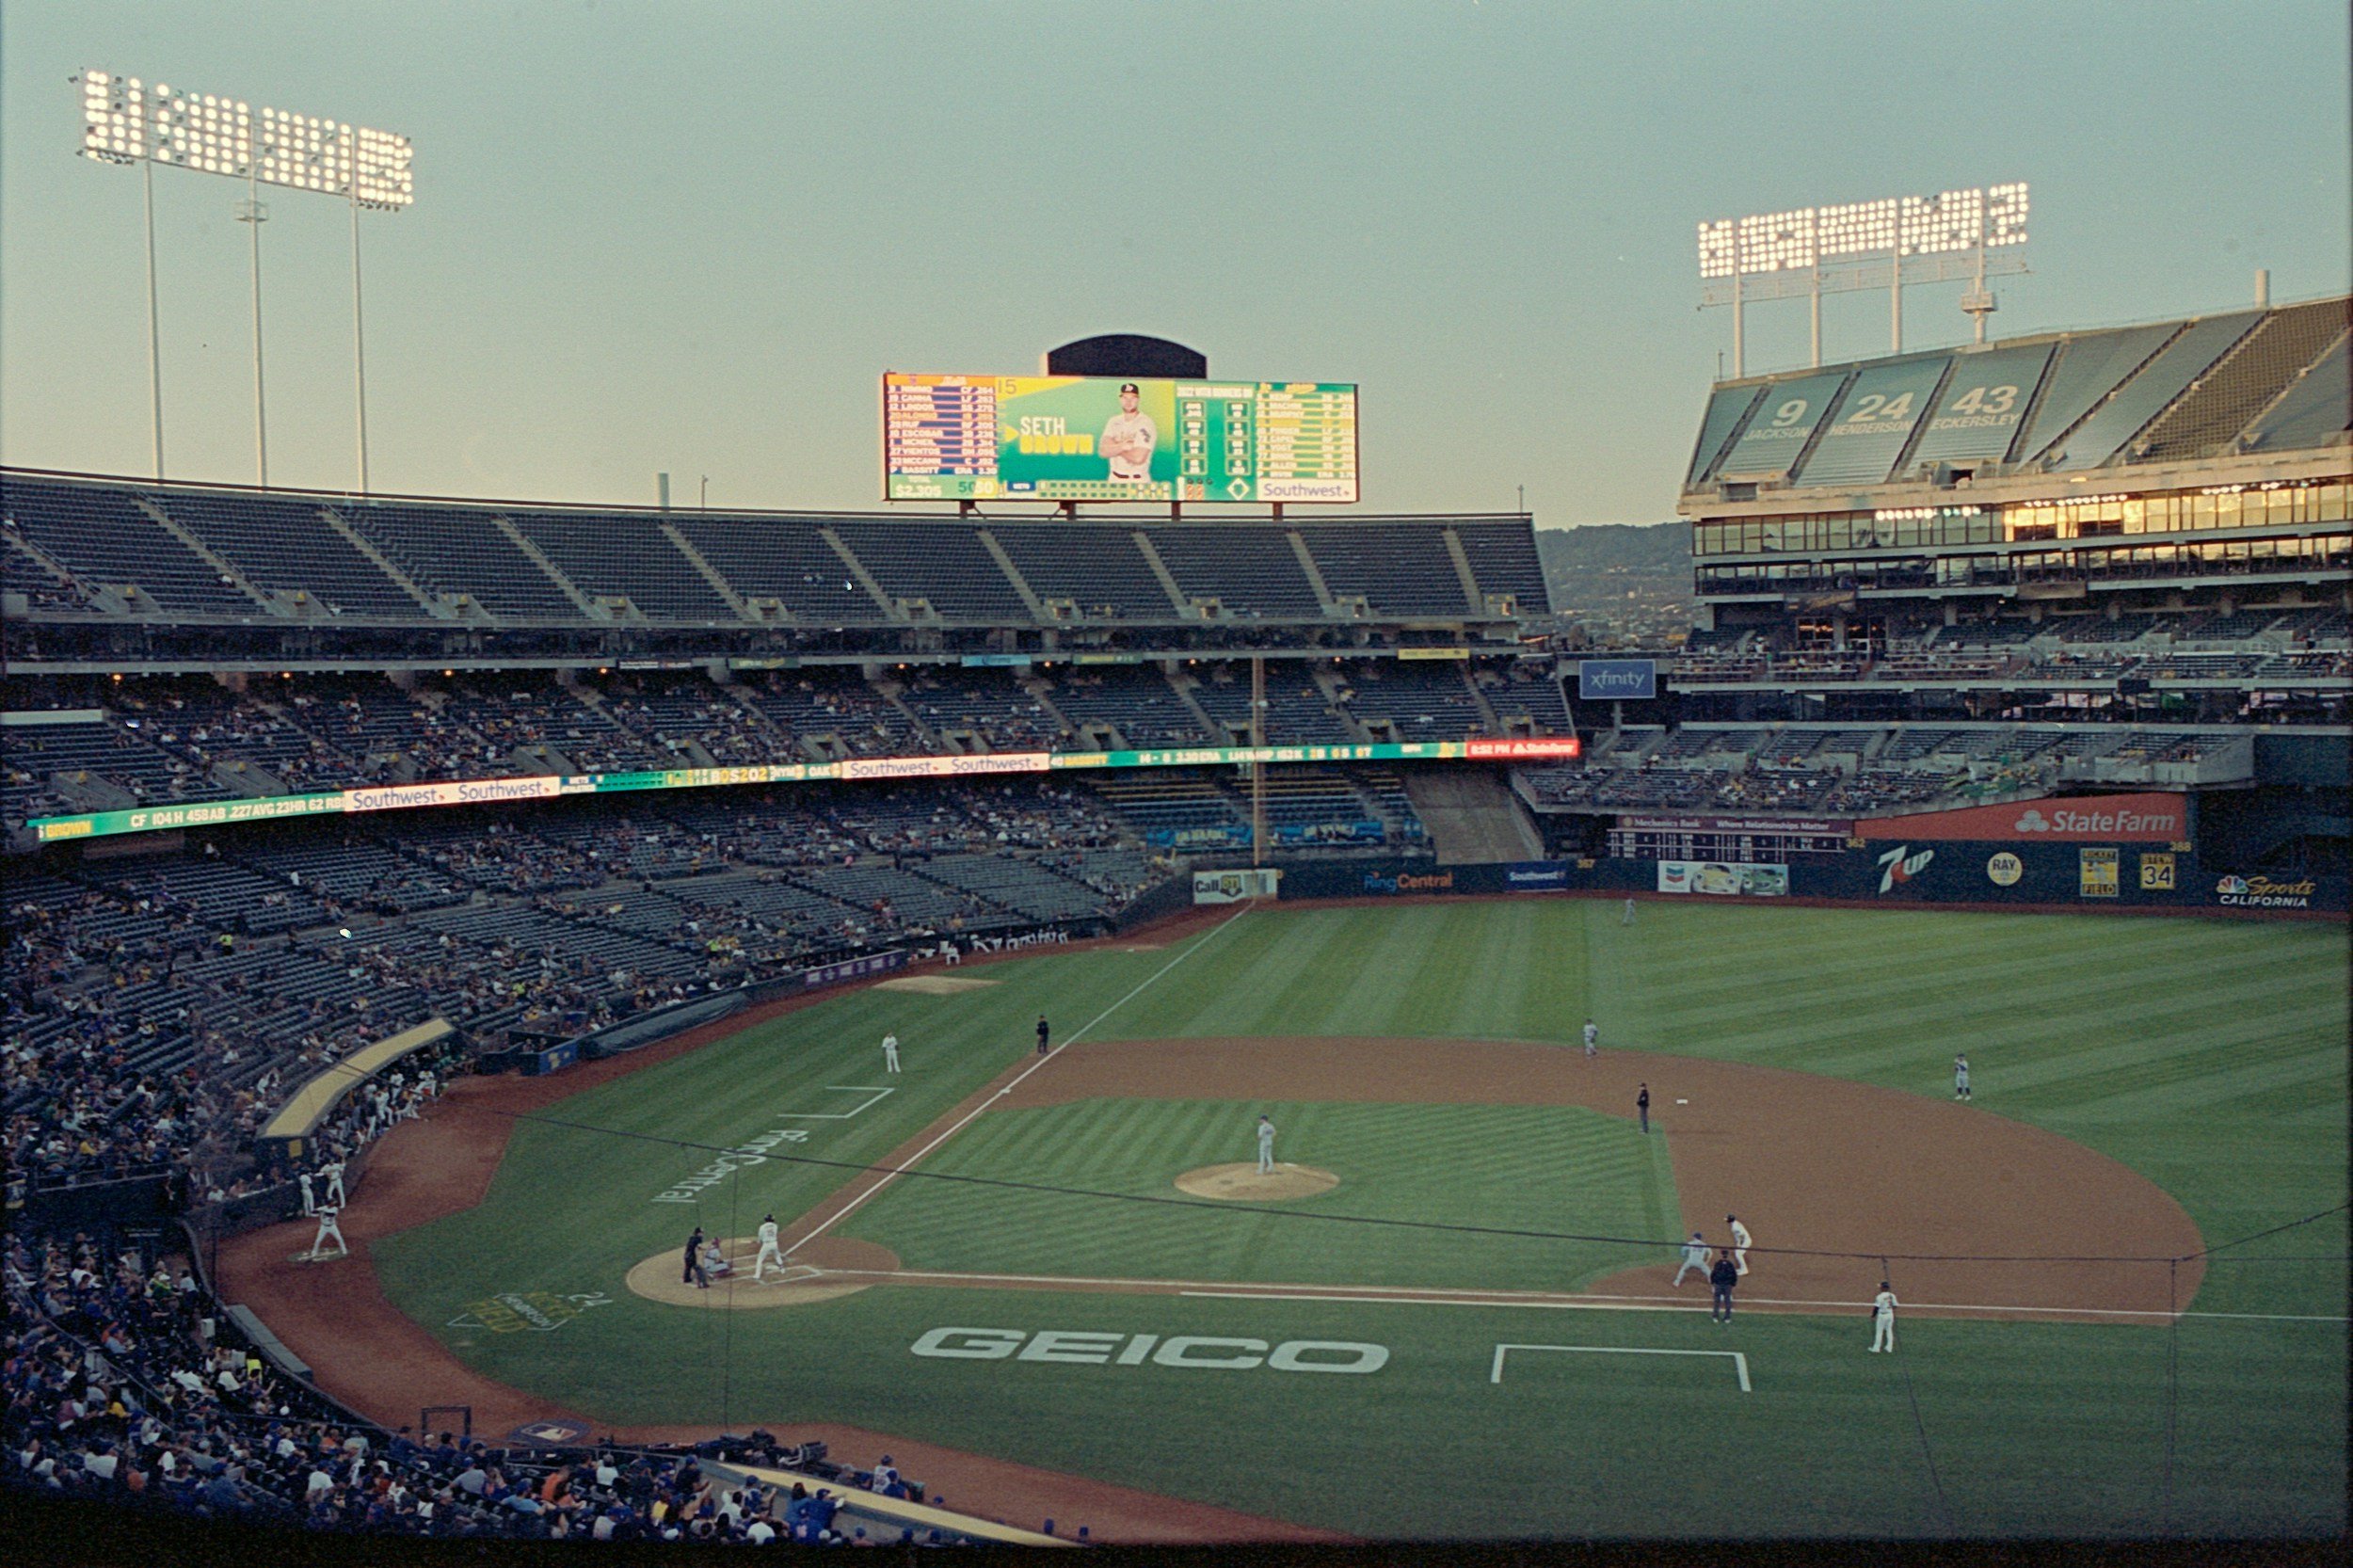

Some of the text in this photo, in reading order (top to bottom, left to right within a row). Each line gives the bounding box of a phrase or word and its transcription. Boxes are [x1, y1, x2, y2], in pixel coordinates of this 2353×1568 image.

[998, 379, 1016, 394] 15
[1848, 392, 1913, 423] 24
[1950, 386, 2018, 414] 43
[1771, 399, 1807, 426] 9
[1020, 416, 1065, 436] SETH
[1828, 420, 1913, 437] HENDERSON
[1930, 413, 2020, 430] ECKERSLEY
[1744, 426, 1811, 441] JACKSON
[1019, 434, 1094, 455] BROWN
[1264, 483, 1342, 497] Southwest
[1591, 670, 1645, 689] xfinity
[850, 761, 931, 776] Southwest
[952, 758, 1032, 772] Southwest
[352, 788, 437, 809] Southwest
[458, 781, 543, 801] Southwest
[46, 820, 91, 838] BROWN
[131, 814, 147, 827] CF
[253, 803, 275, 816] AVG
[276, 801, 289, 814] 23
[290, 799, 306, 812] HR
[309, 798, 323, 810] 62
[1634, 818, 1677, 827] Mechanics
[1679, 819, 1700, 827] Bank
[1744, 821, 1799, 830] Relationships
[1993, 858, 2017, 871] RAY
[1509, 872, 1557, 882] Southwest
[2144, 865, 2171, 886] 34
[1195, 880, 1219, 893] Call
[2083, 885, 2115, 893] FIELD
[2247, 876, 2316, 896] Sports
[2219, 895, 2308, 907] CALIFORNIA
[910, 1327, 1390, 1373] GEICO
